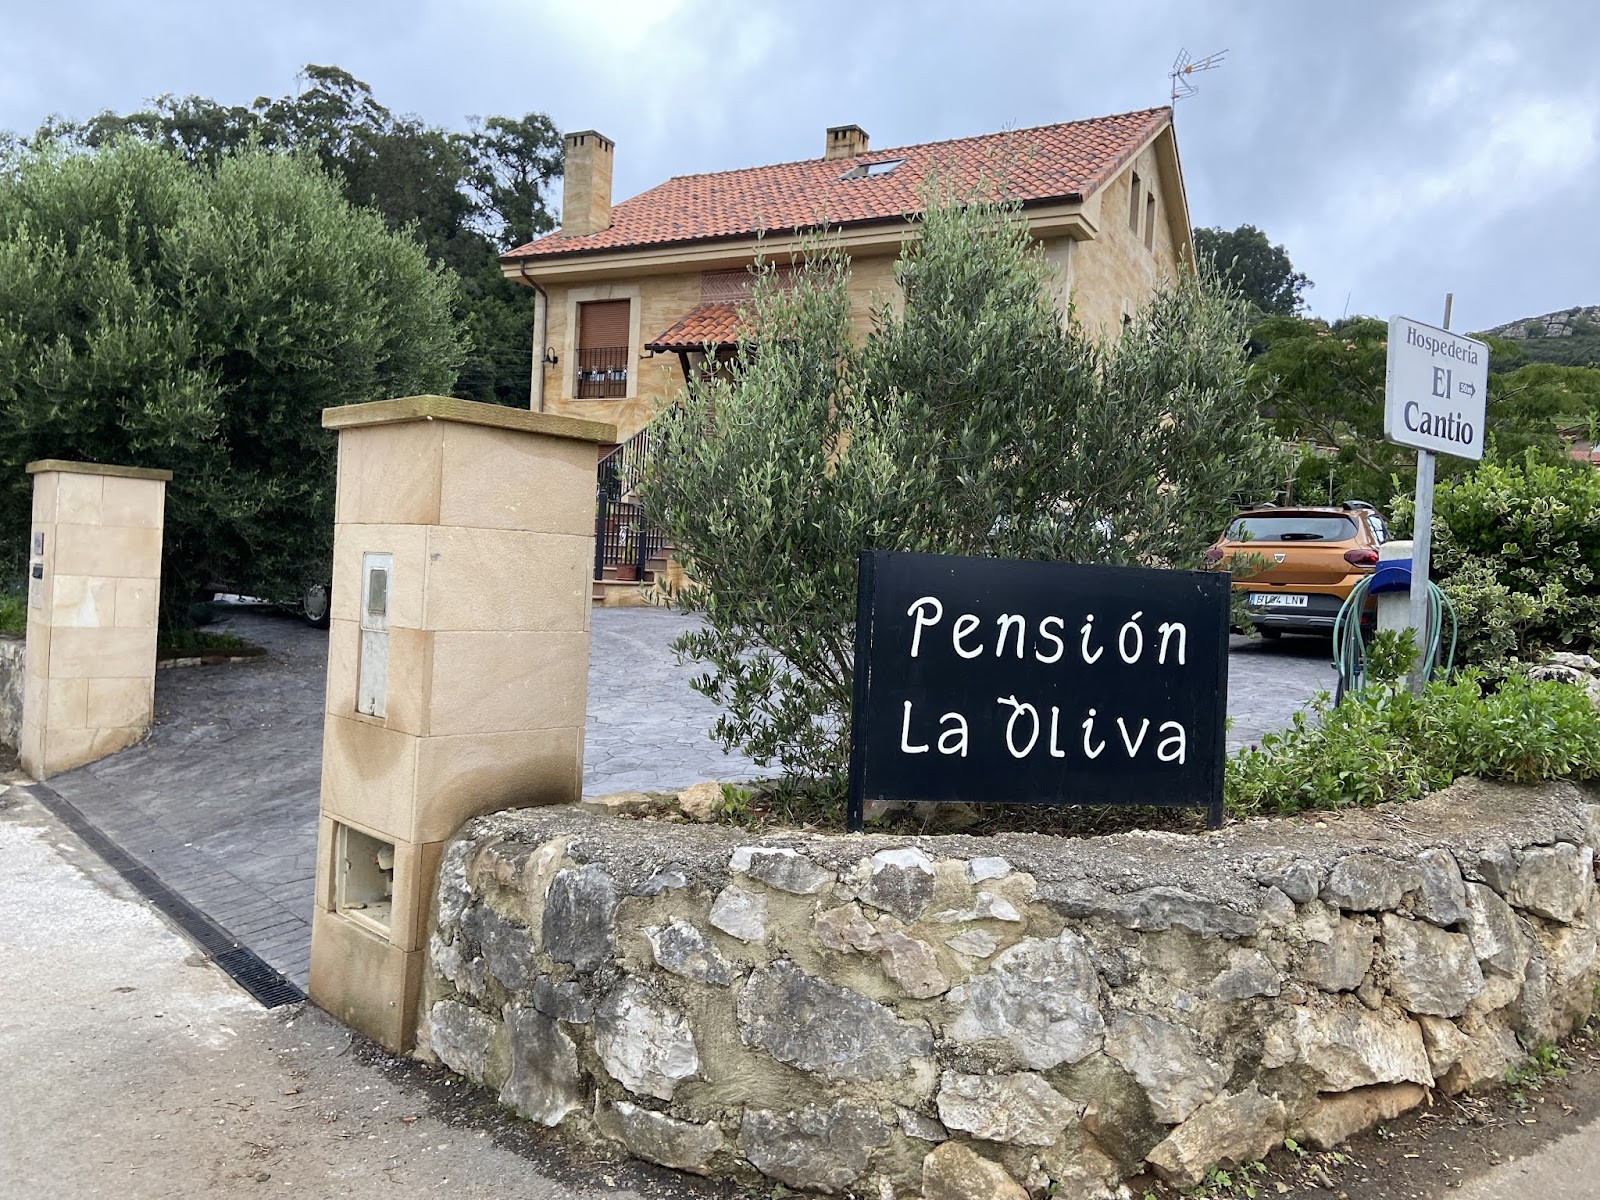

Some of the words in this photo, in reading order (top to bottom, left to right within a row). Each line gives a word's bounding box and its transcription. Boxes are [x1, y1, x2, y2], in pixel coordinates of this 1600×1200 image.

[1407, 326, 1478, 365] Hospedería
[1432, 366, 1452, 399] El
[1460, 383, 1473, 395] 50m
[1404, 400, 1474, 444] Cantio
[907, 596, 1187, 665] Pensión
[901, 700, 969, 758] La
[997, 694, 1187, 765] Oliva
